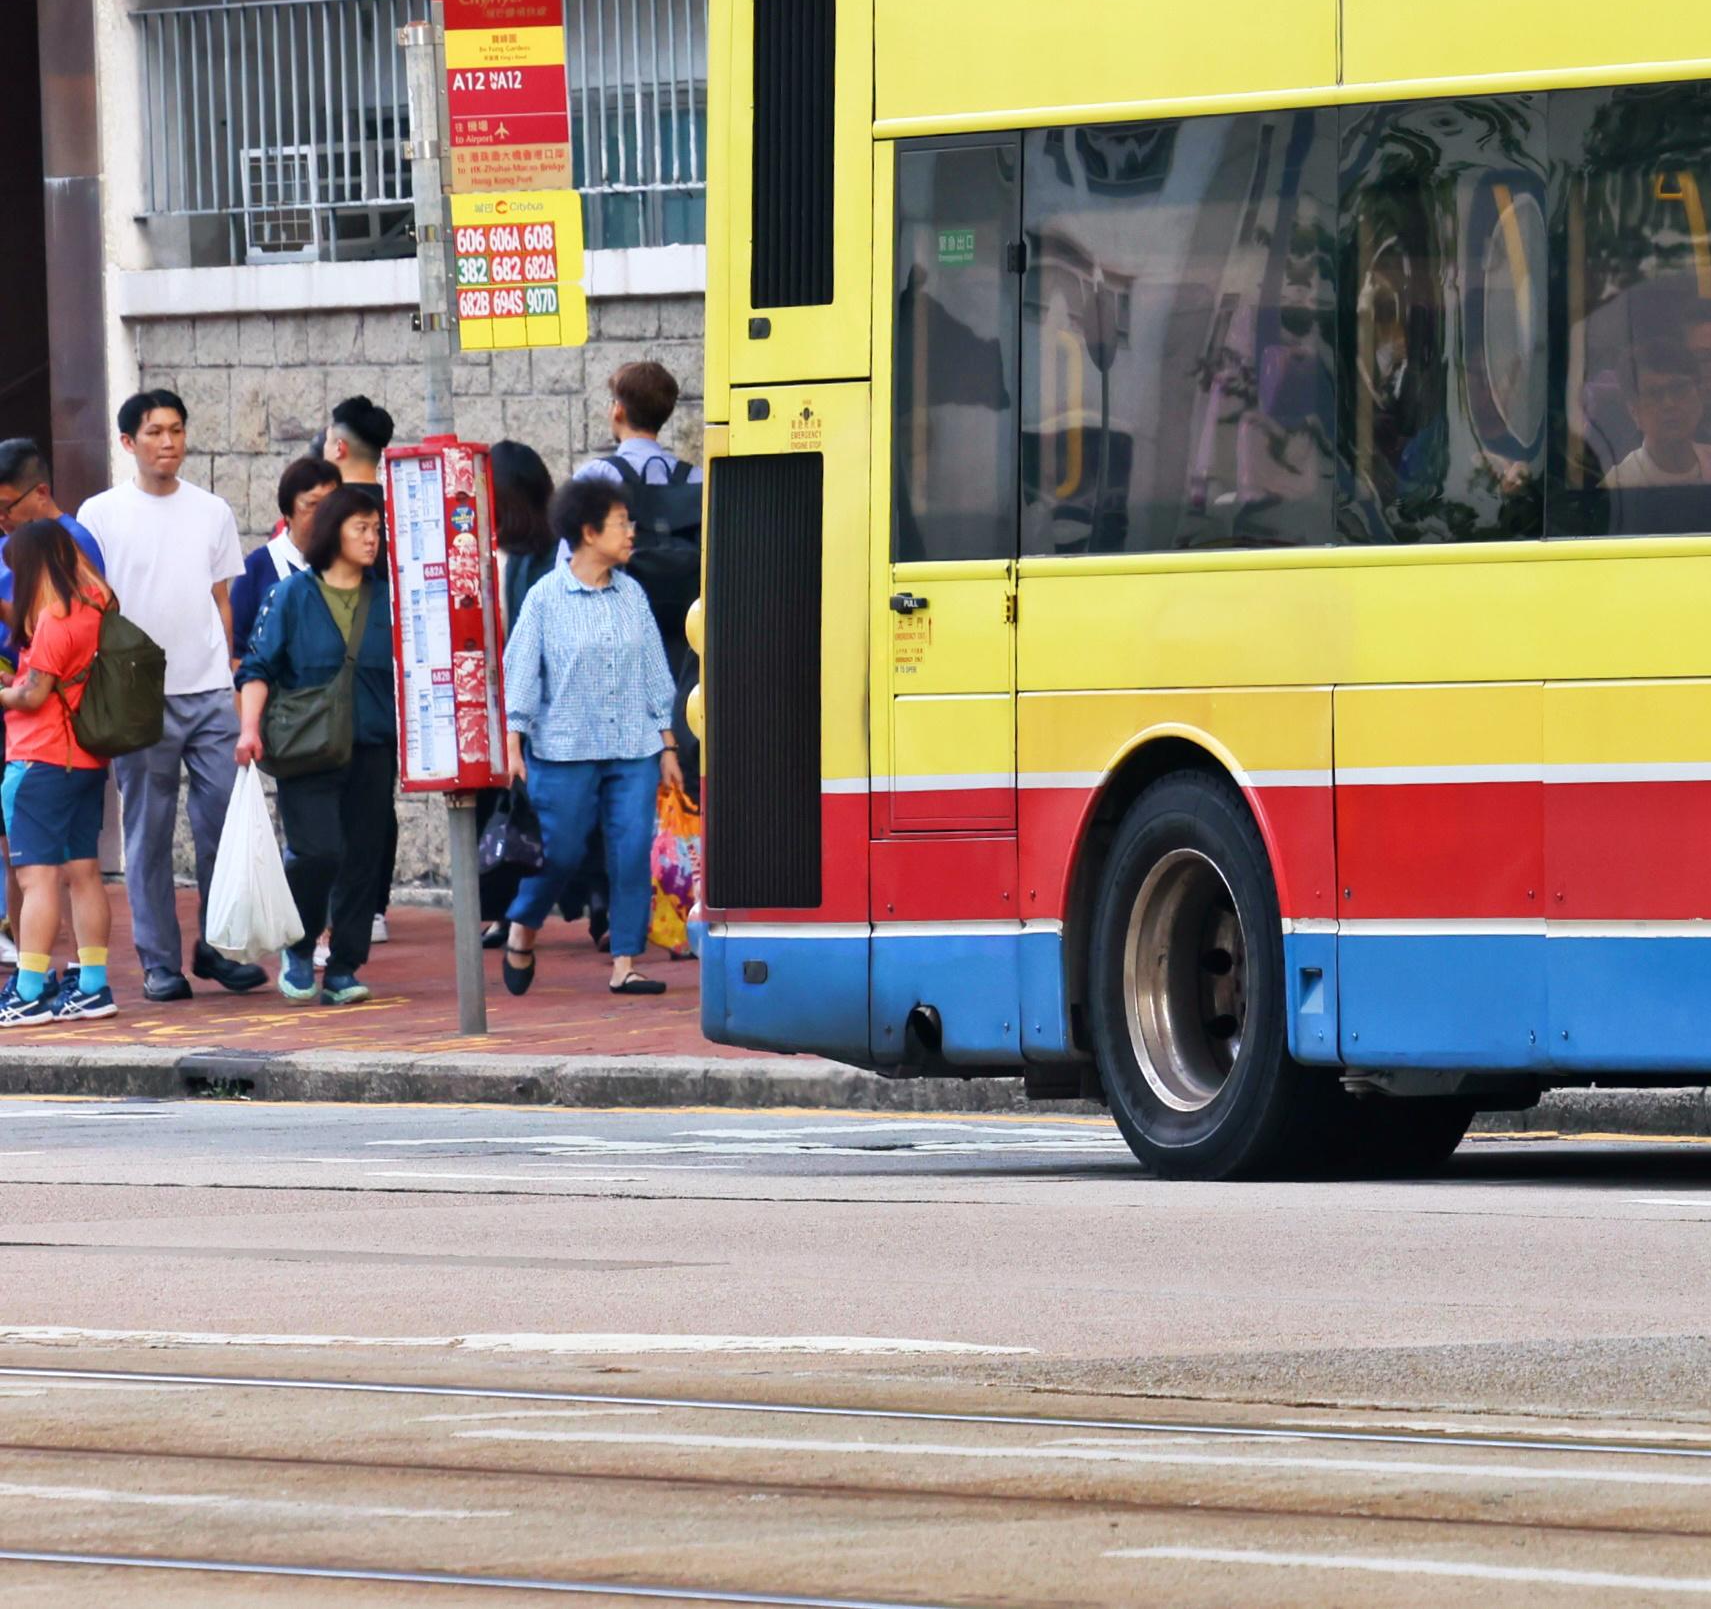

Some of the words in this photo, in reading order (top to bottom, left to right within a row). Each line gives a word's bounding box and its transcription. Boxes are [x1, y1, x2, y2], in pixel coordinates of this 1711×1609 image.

[453, 72, 485, 91] A12
[466, 134, 494, 144] Airport
[510, 202, 544, 211] Citybus
[457, 227, 486, 253] 606
[490, 226, 521, 251] 606A
[524, 225, 553, 250] 608
[458, 258, 488, 283] 382
[492, 256, 522, 281] 682
[525, 255, 556, 280] 682A
[460, 291, 490, 316] 682B
[493, 290, 524, 315] 694S
[526, 288, 556, 314] 907D
[903, 599, 918, 608] PULL
